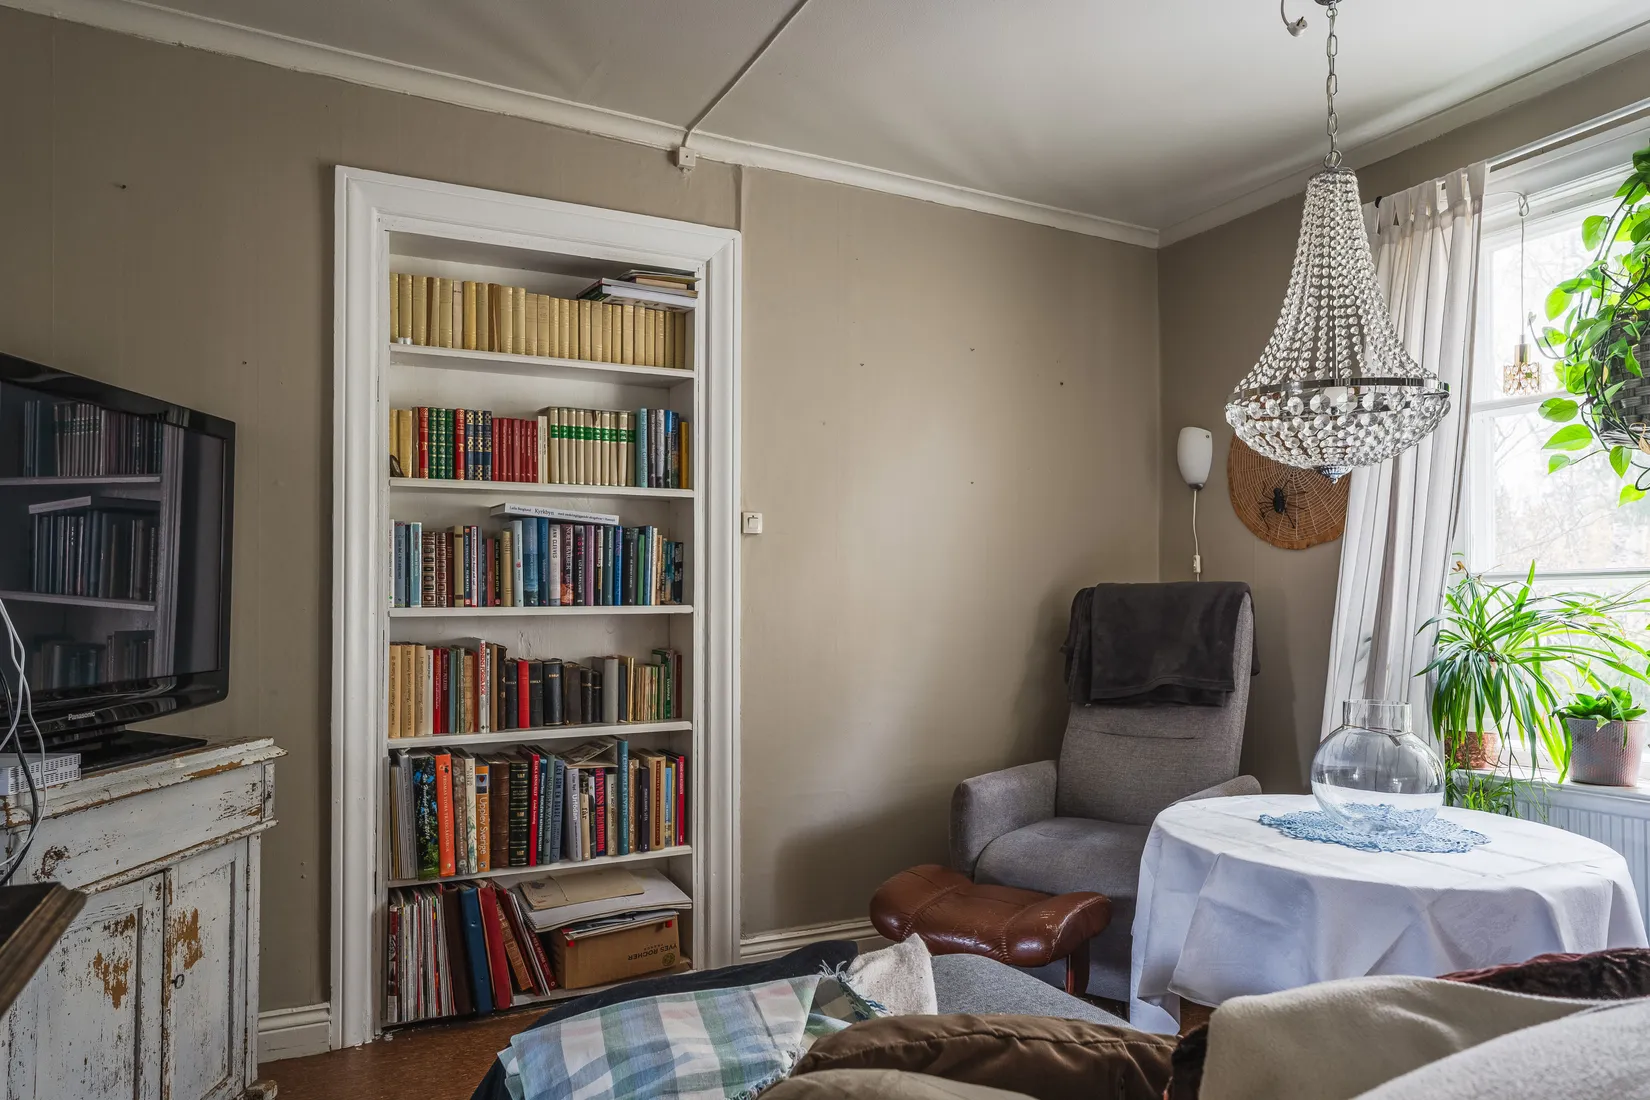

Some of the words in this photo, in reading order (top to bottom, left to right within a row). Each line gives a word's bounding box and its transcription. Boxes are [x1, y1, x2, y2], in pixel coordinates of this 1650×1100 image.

[534, 508, 555, 516] Kyrkbyn
[68, 711, 95, 721] Panasonic
[555, 765, 563, 776] LEV
[545, 776, 553, 810] NORDISKA
[596, 768, 605, 805] GUINNESS
[478, 796, 488, 825] Upplev
[571, 793, 579, 821] Urfödan
[477, 826, 488, 855] Sverige
[596, 806, 605, 852] REKORDBOK
[627, 948, 659, 961] ROCHER
[660, 943, 678, 952] YVES
